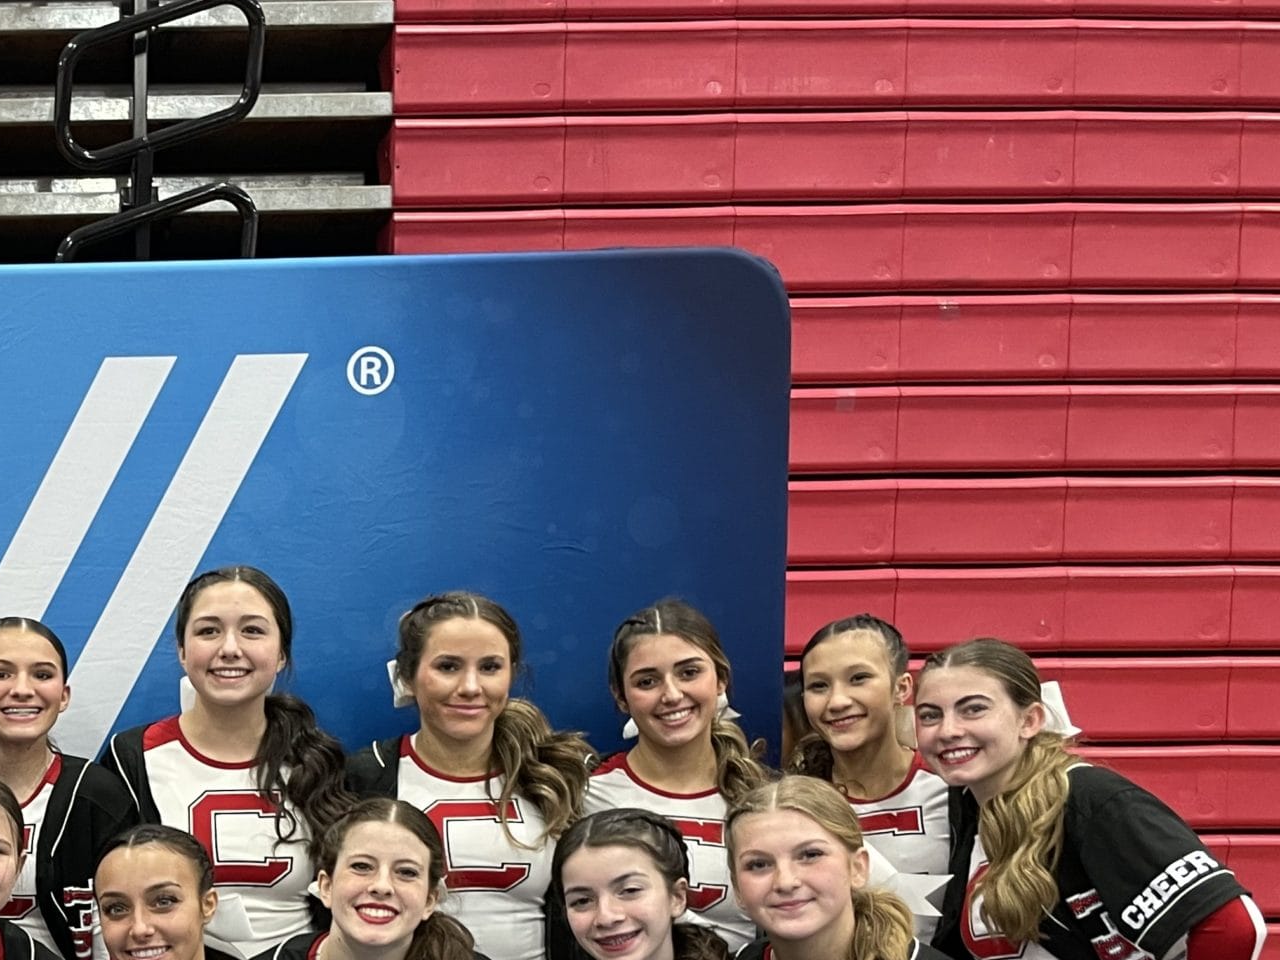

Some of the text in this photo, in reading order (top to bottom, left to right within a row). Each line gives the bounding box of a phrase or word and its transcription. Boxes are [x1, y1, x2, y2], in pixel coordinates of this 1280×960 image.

[187, 790, 294, 888] C
[422, 799, 530, 893] C
[1121, 850, 1219, 930] CHEER
